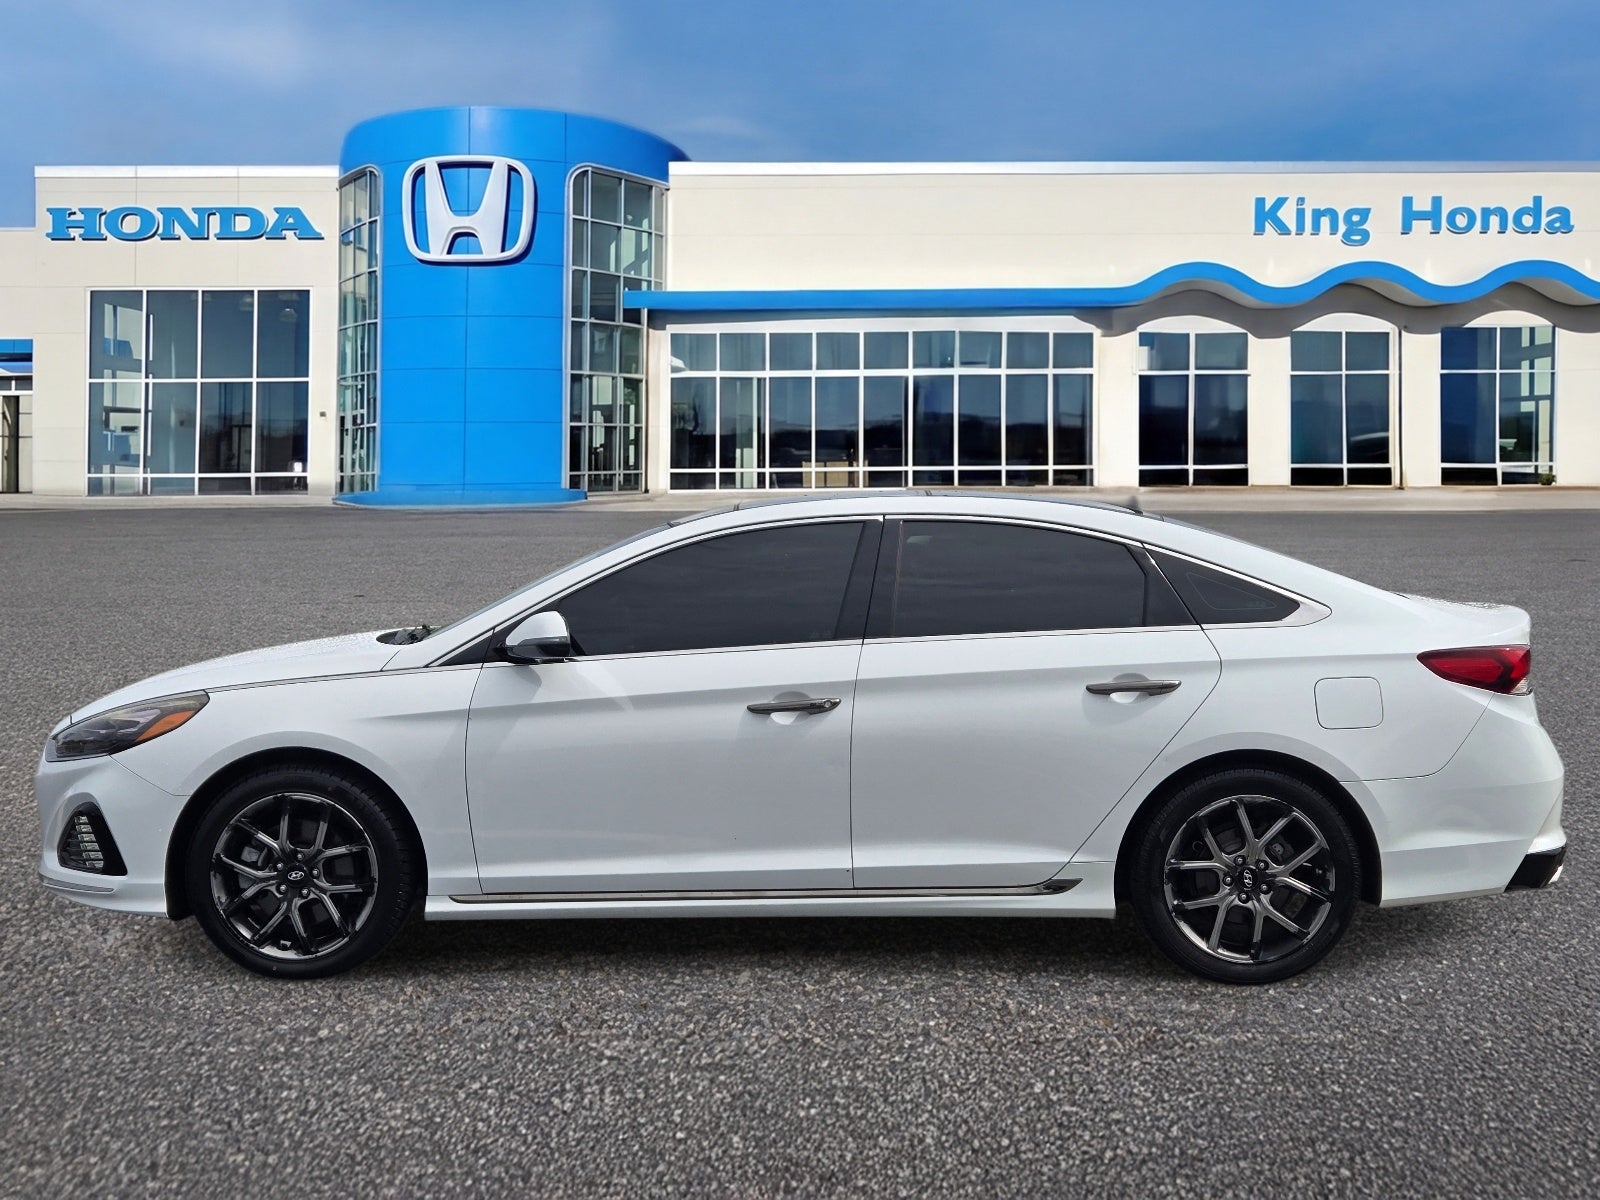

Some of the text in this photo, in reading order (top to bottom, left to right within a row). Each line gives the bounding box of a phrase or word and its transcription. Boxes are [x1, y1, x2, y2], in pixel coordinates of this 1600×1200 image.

[46, 206, 324, 241] HONDA
[1254, 196, 1575, 246] King Honda
